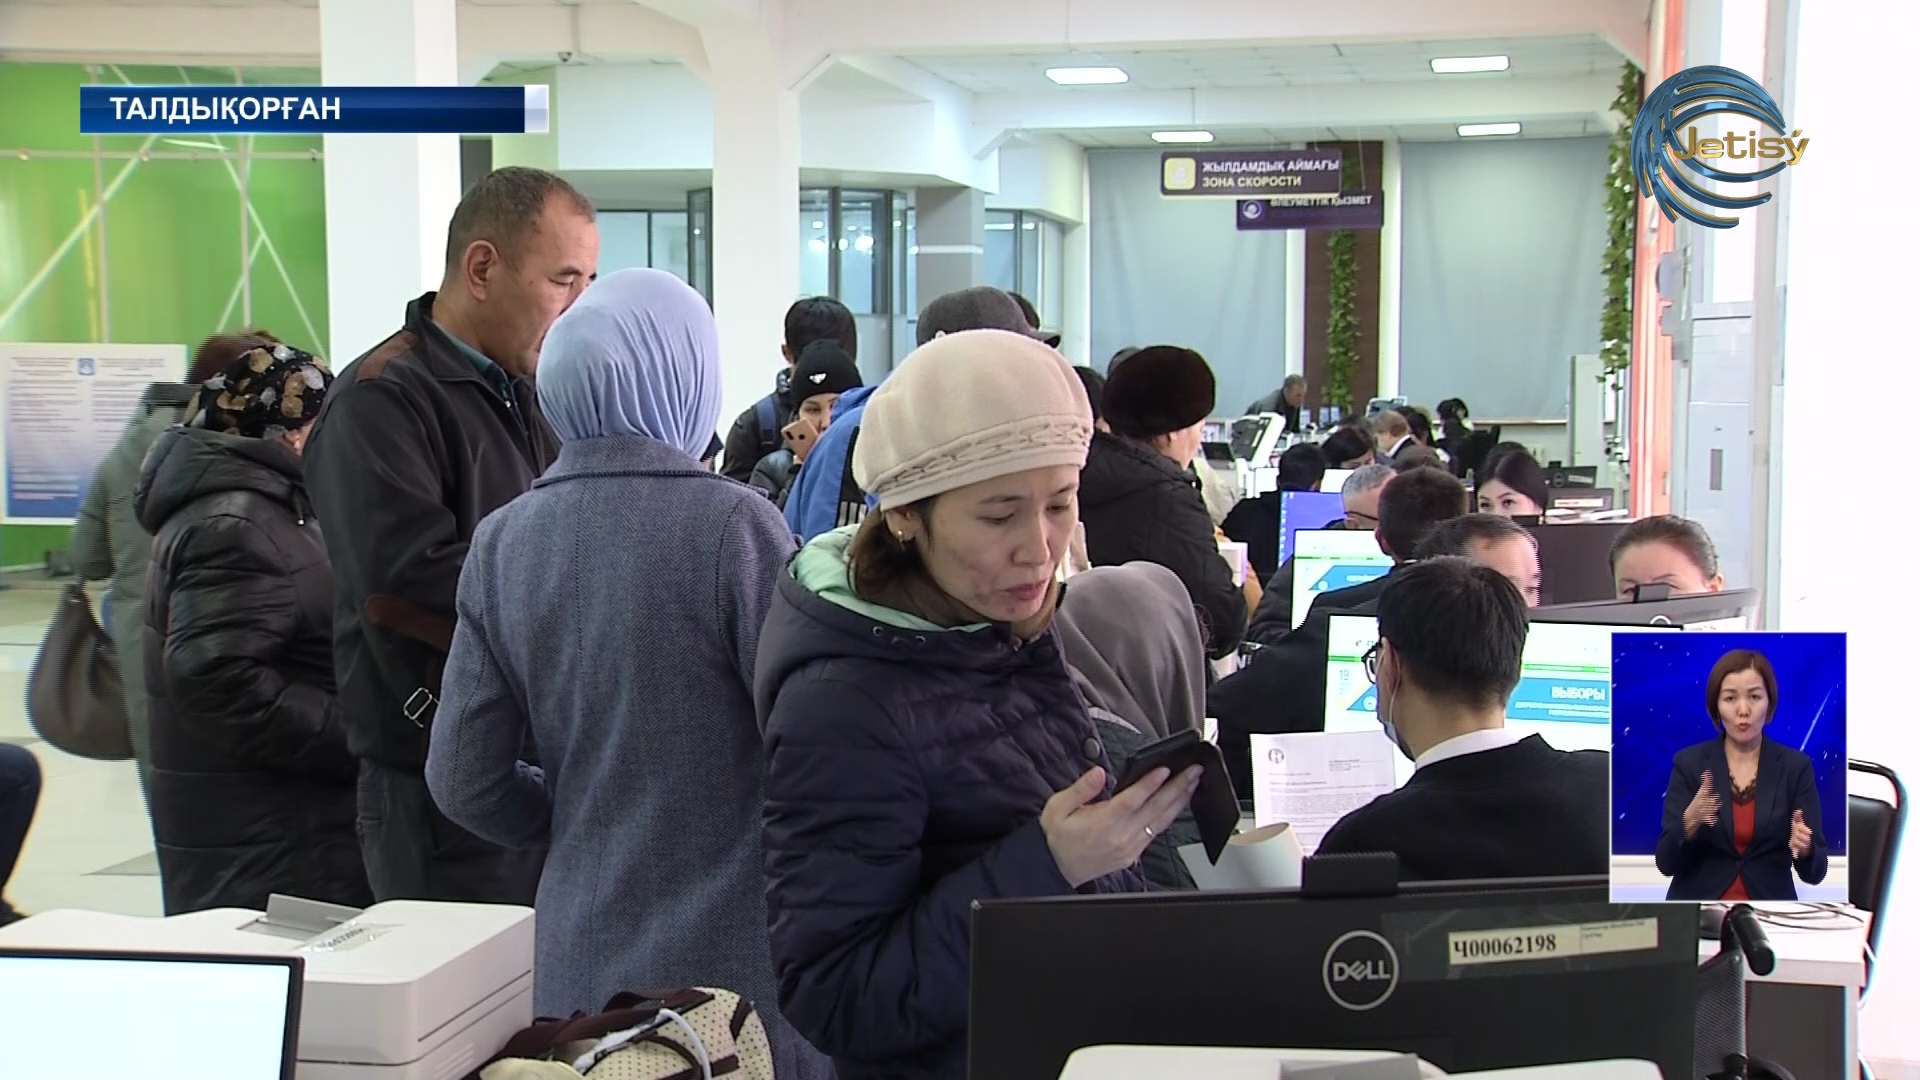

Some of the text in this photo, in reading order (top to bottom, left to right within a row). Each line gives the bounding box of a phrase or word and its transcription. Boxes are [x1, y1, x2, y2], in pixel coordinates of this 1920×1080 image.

[1202, 161, 1285, 173] ЖЫЛДАМДЫҚ
[1202, 175, 1301, 188] ЗОНА СКОРОСТИ
[1551, 685, 1606, 701] ВЫБОРЫ
[1453, 933, 1557, 958] Ч00062198
[1332, 960, 1391, 983] DELL
